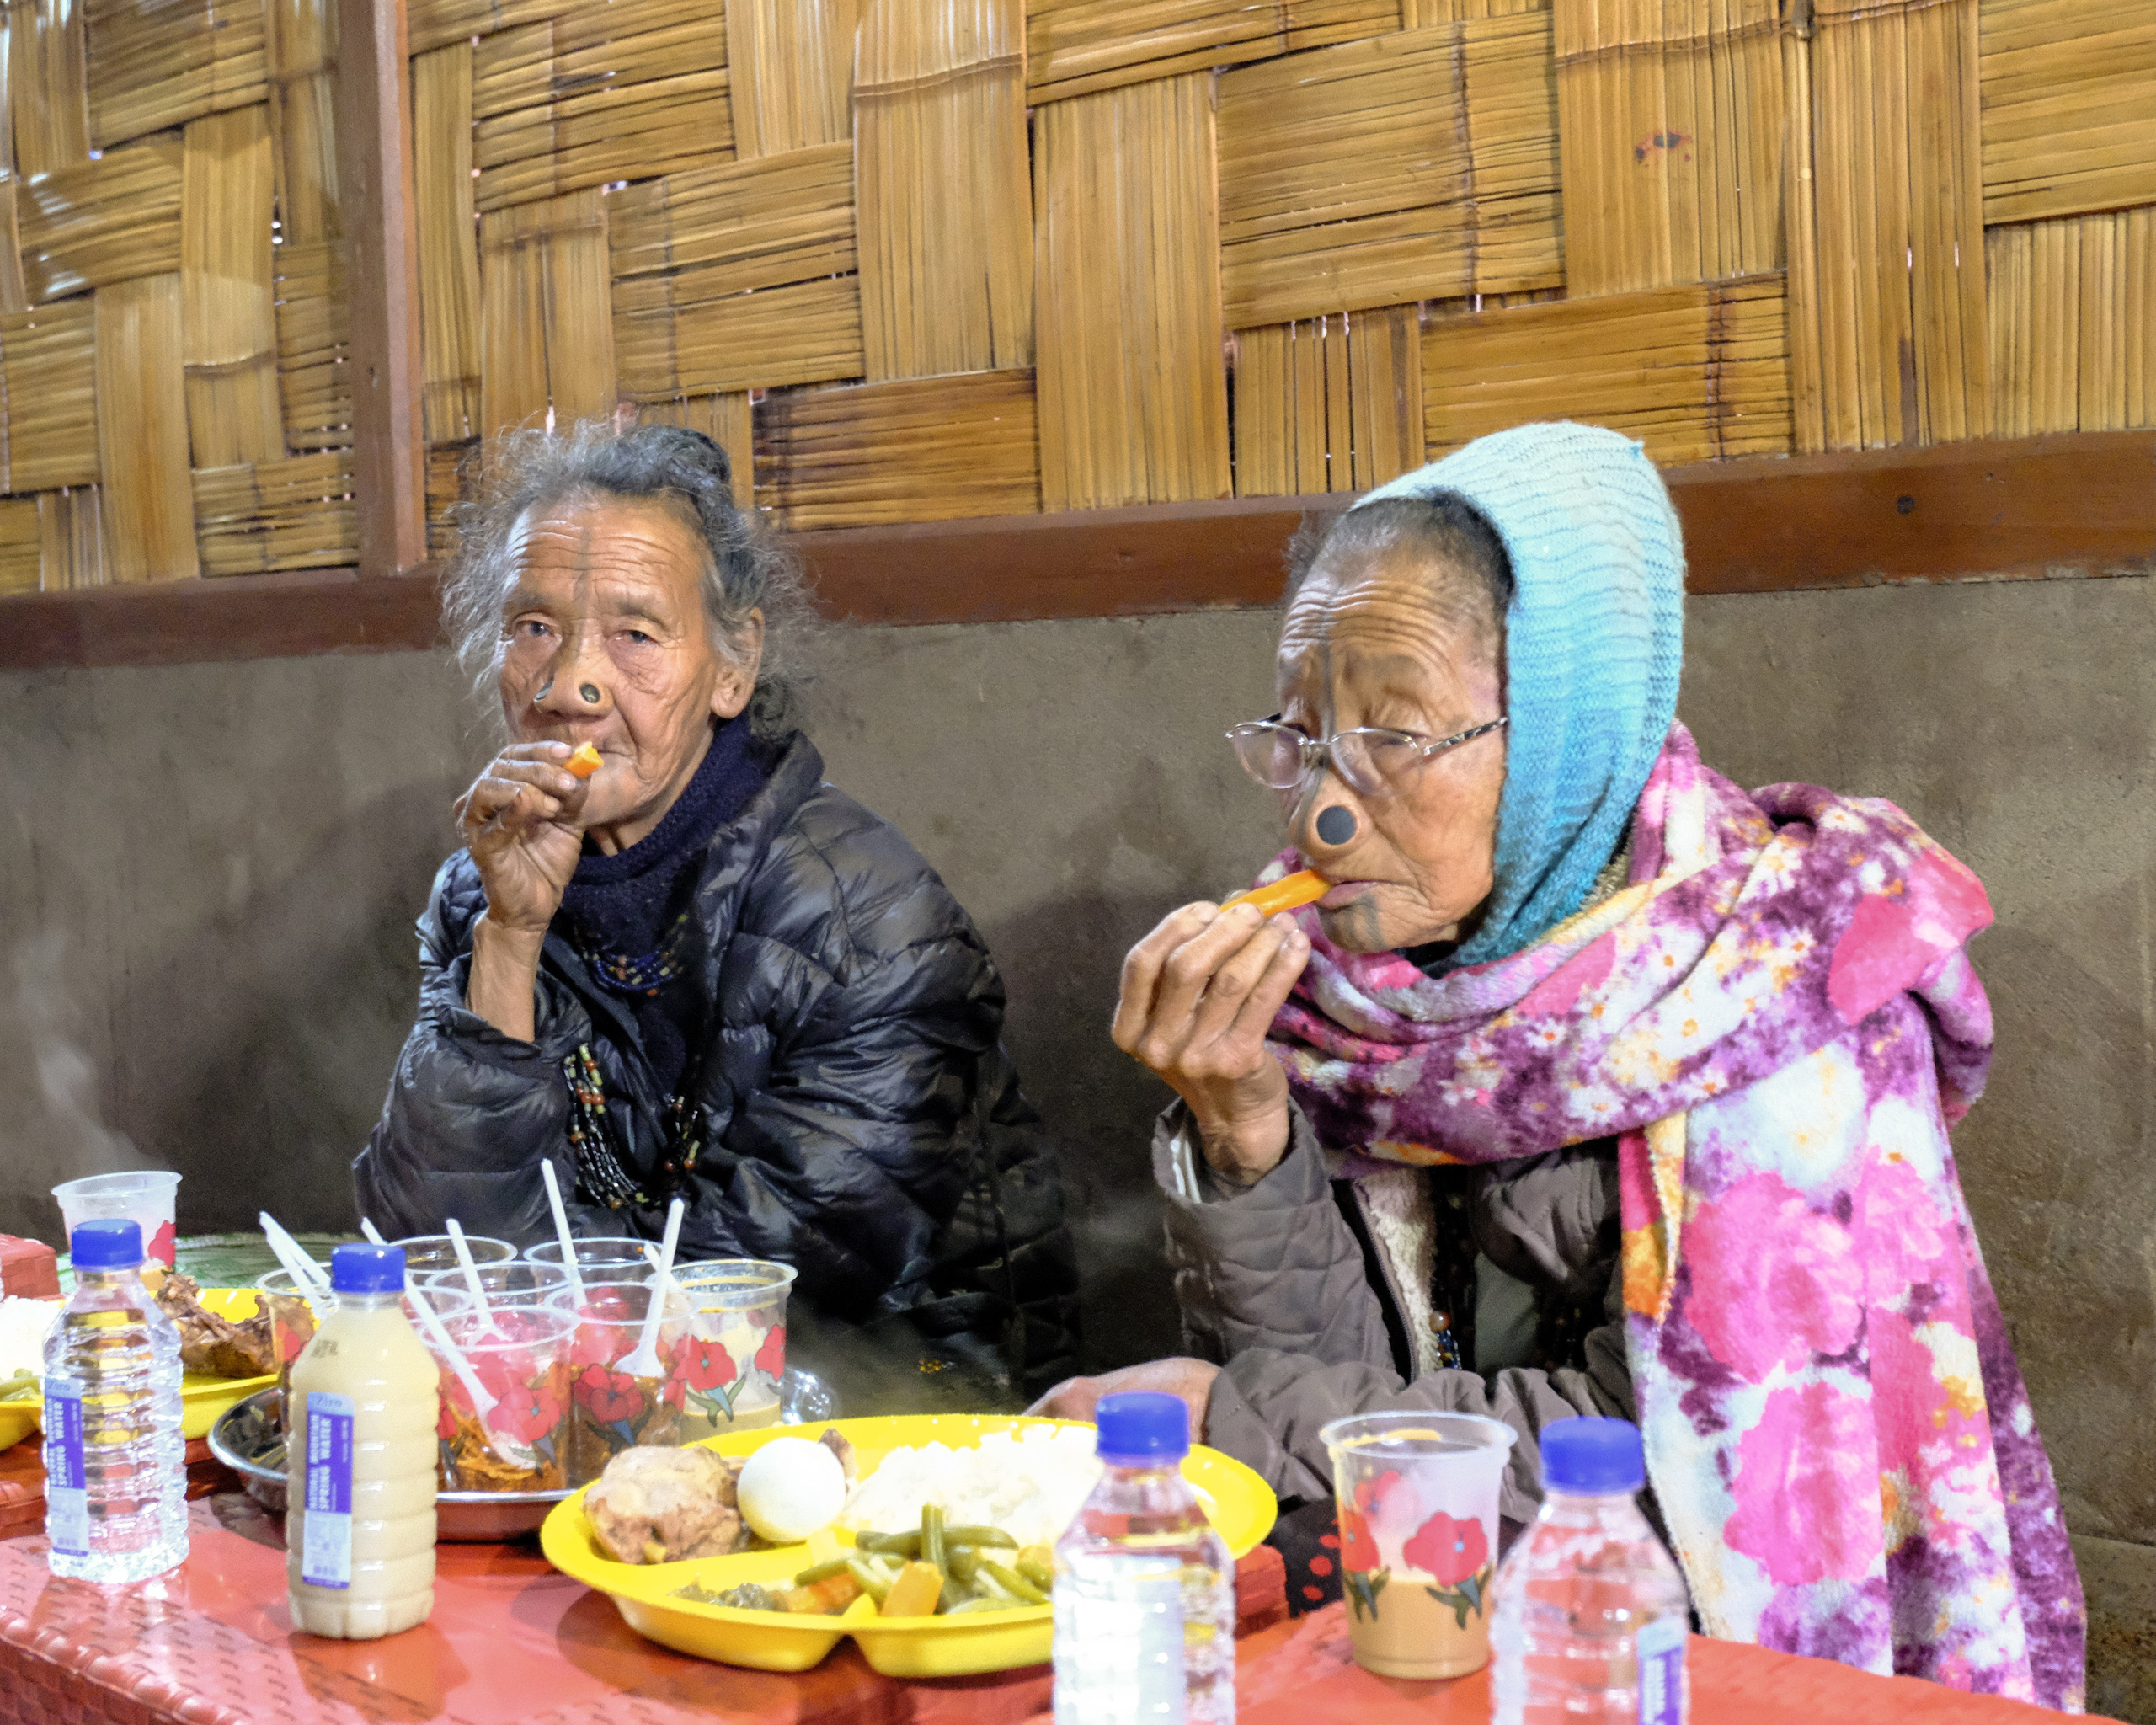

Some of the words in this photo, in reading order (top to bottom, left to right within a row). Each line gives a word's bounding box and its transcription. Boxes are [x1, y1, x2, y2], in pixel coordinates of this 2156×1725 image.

[54, 1402, 64, 1439] WATER
[310, 1414, 319, 1464] MOUNTAIN
[320, 1418, 332, 1460] WATER
[56, 1445, 67, 1486] SPRING
[319, 1466, 330, 1510] SPRING
